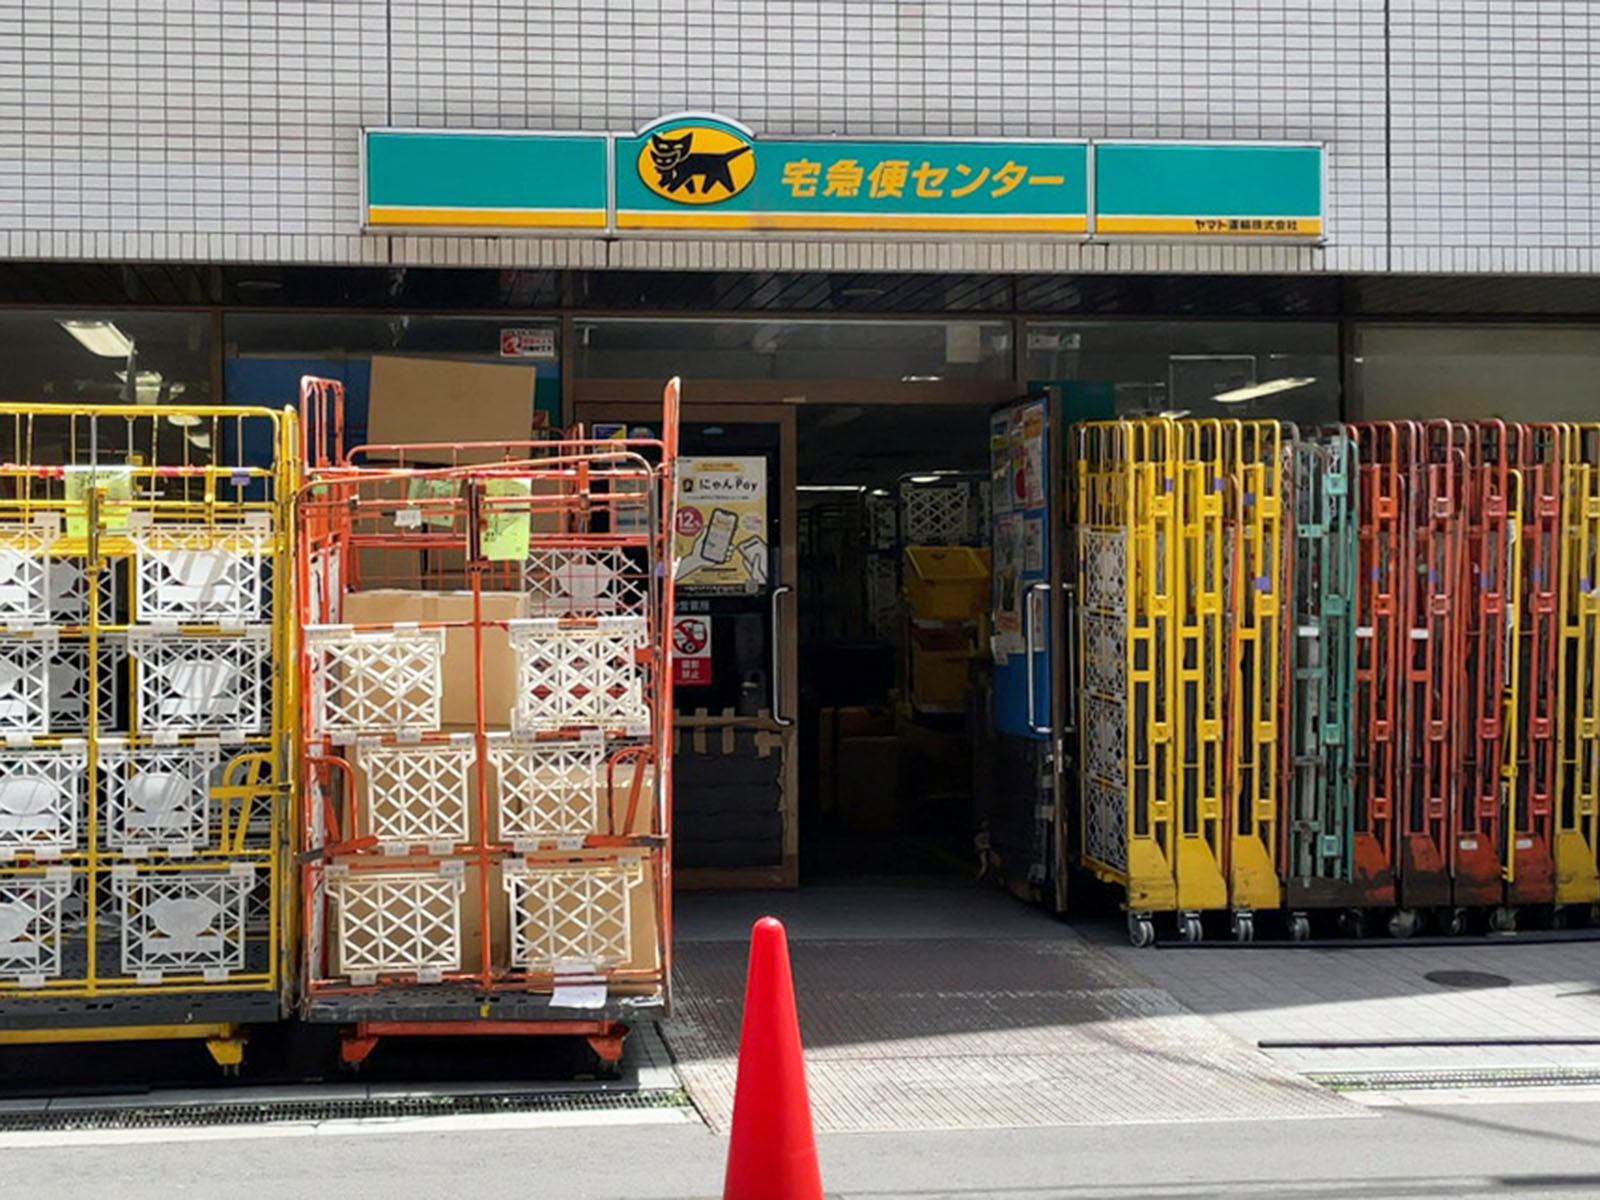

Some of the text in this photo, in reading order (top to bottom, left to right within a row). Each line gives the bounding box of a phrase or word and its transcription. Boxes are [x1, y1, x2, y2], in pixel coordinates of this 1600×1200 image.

[781, 158, 1065, 199] 宅急便センター
[1195, 219, 1298, 231] ヤマト運輸株式会社
